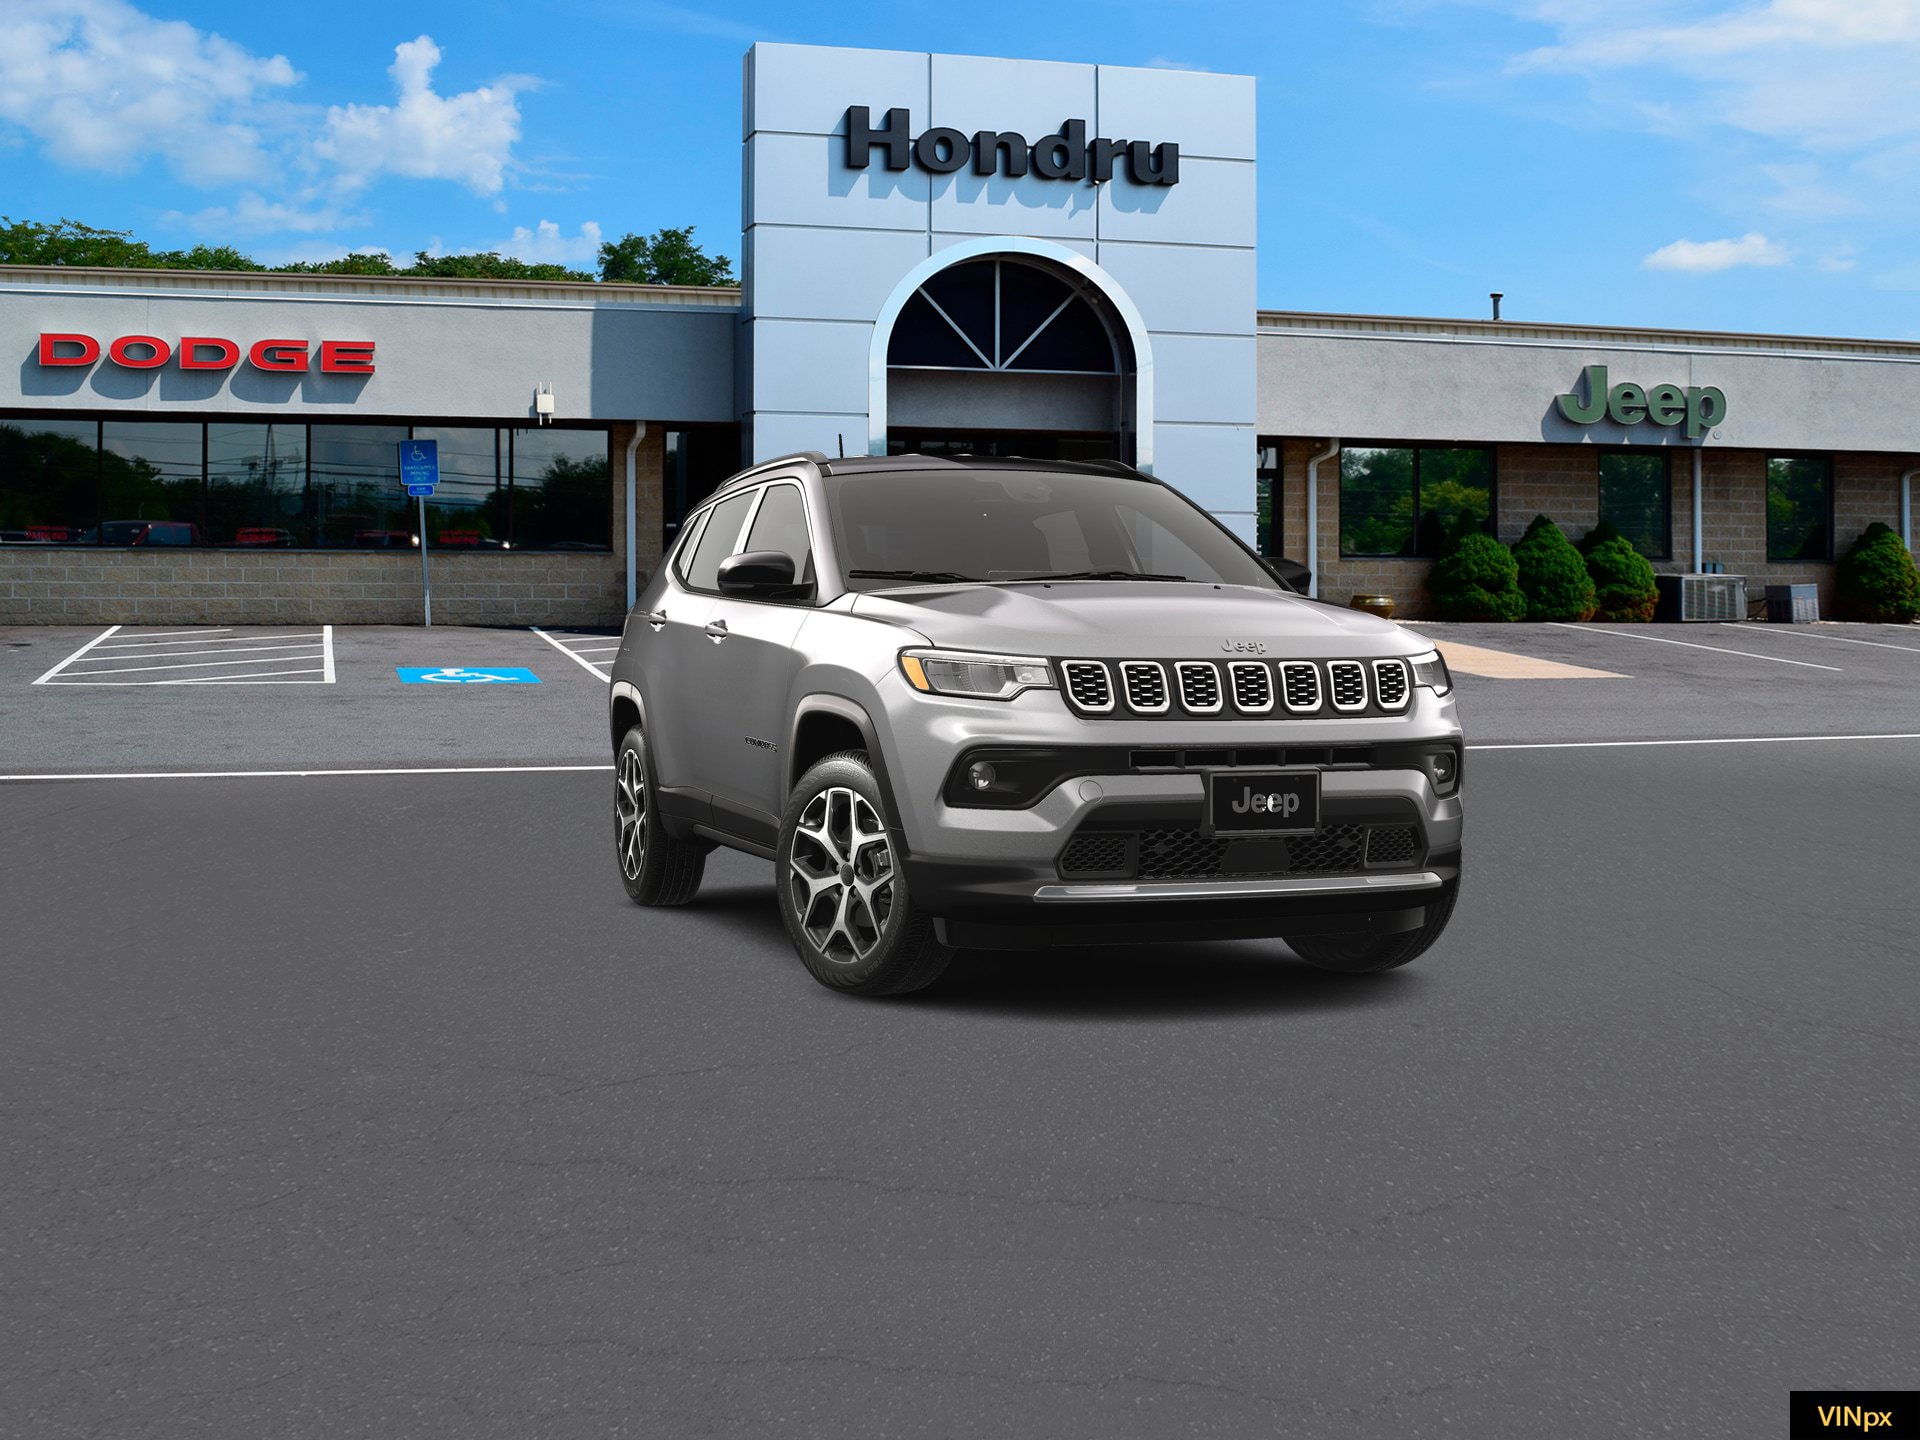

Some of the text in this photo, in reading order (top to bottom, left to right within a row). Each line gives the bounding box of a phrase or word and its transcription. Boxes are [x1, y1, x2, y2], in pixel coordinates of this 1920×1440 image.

[845, 105, 1179, 185] Hondru
[38, 332, 376, 375] DODGE
[1557, 364, 1727, 439] Jeep
[1220, 638, 1267, 655] Jeep
[1231, 786, 1300, 818] Jeep
